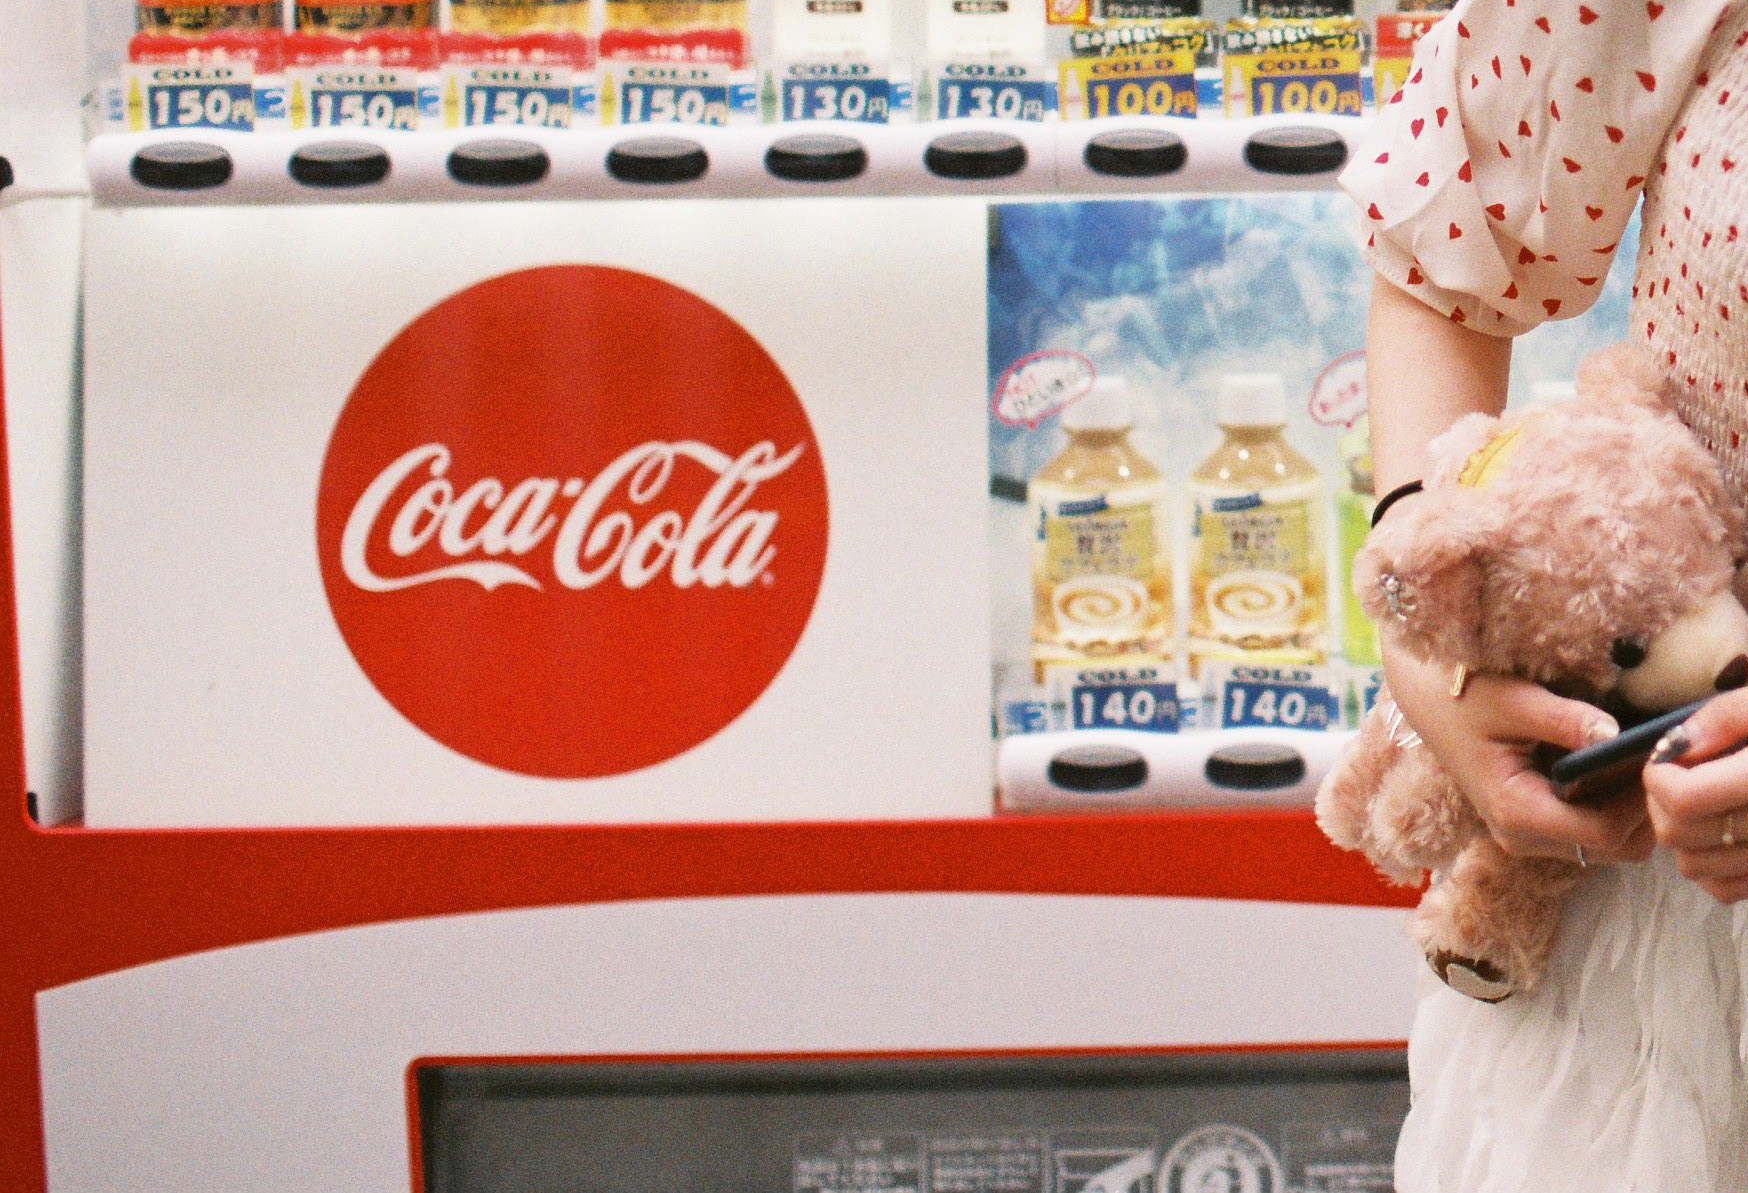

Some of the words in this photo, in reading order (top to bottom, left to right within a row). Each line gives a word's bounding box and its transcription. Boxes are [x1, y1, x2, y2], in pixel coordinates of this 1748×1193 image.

[155, 89, 253, 128] 150円
[318, 94, 418, 130] 150円
[472, 90, 572, 129] 150円
[628, 88, 728, 127] 150円
[790, 86, 887, 120] 130円
[946, 86, 1042, 120] 130円
[1093, 80, 1196, 114] 100円
[1258, 80, 1360, 114] 100円
[341, 442, 806, 592] Coca-Cola
